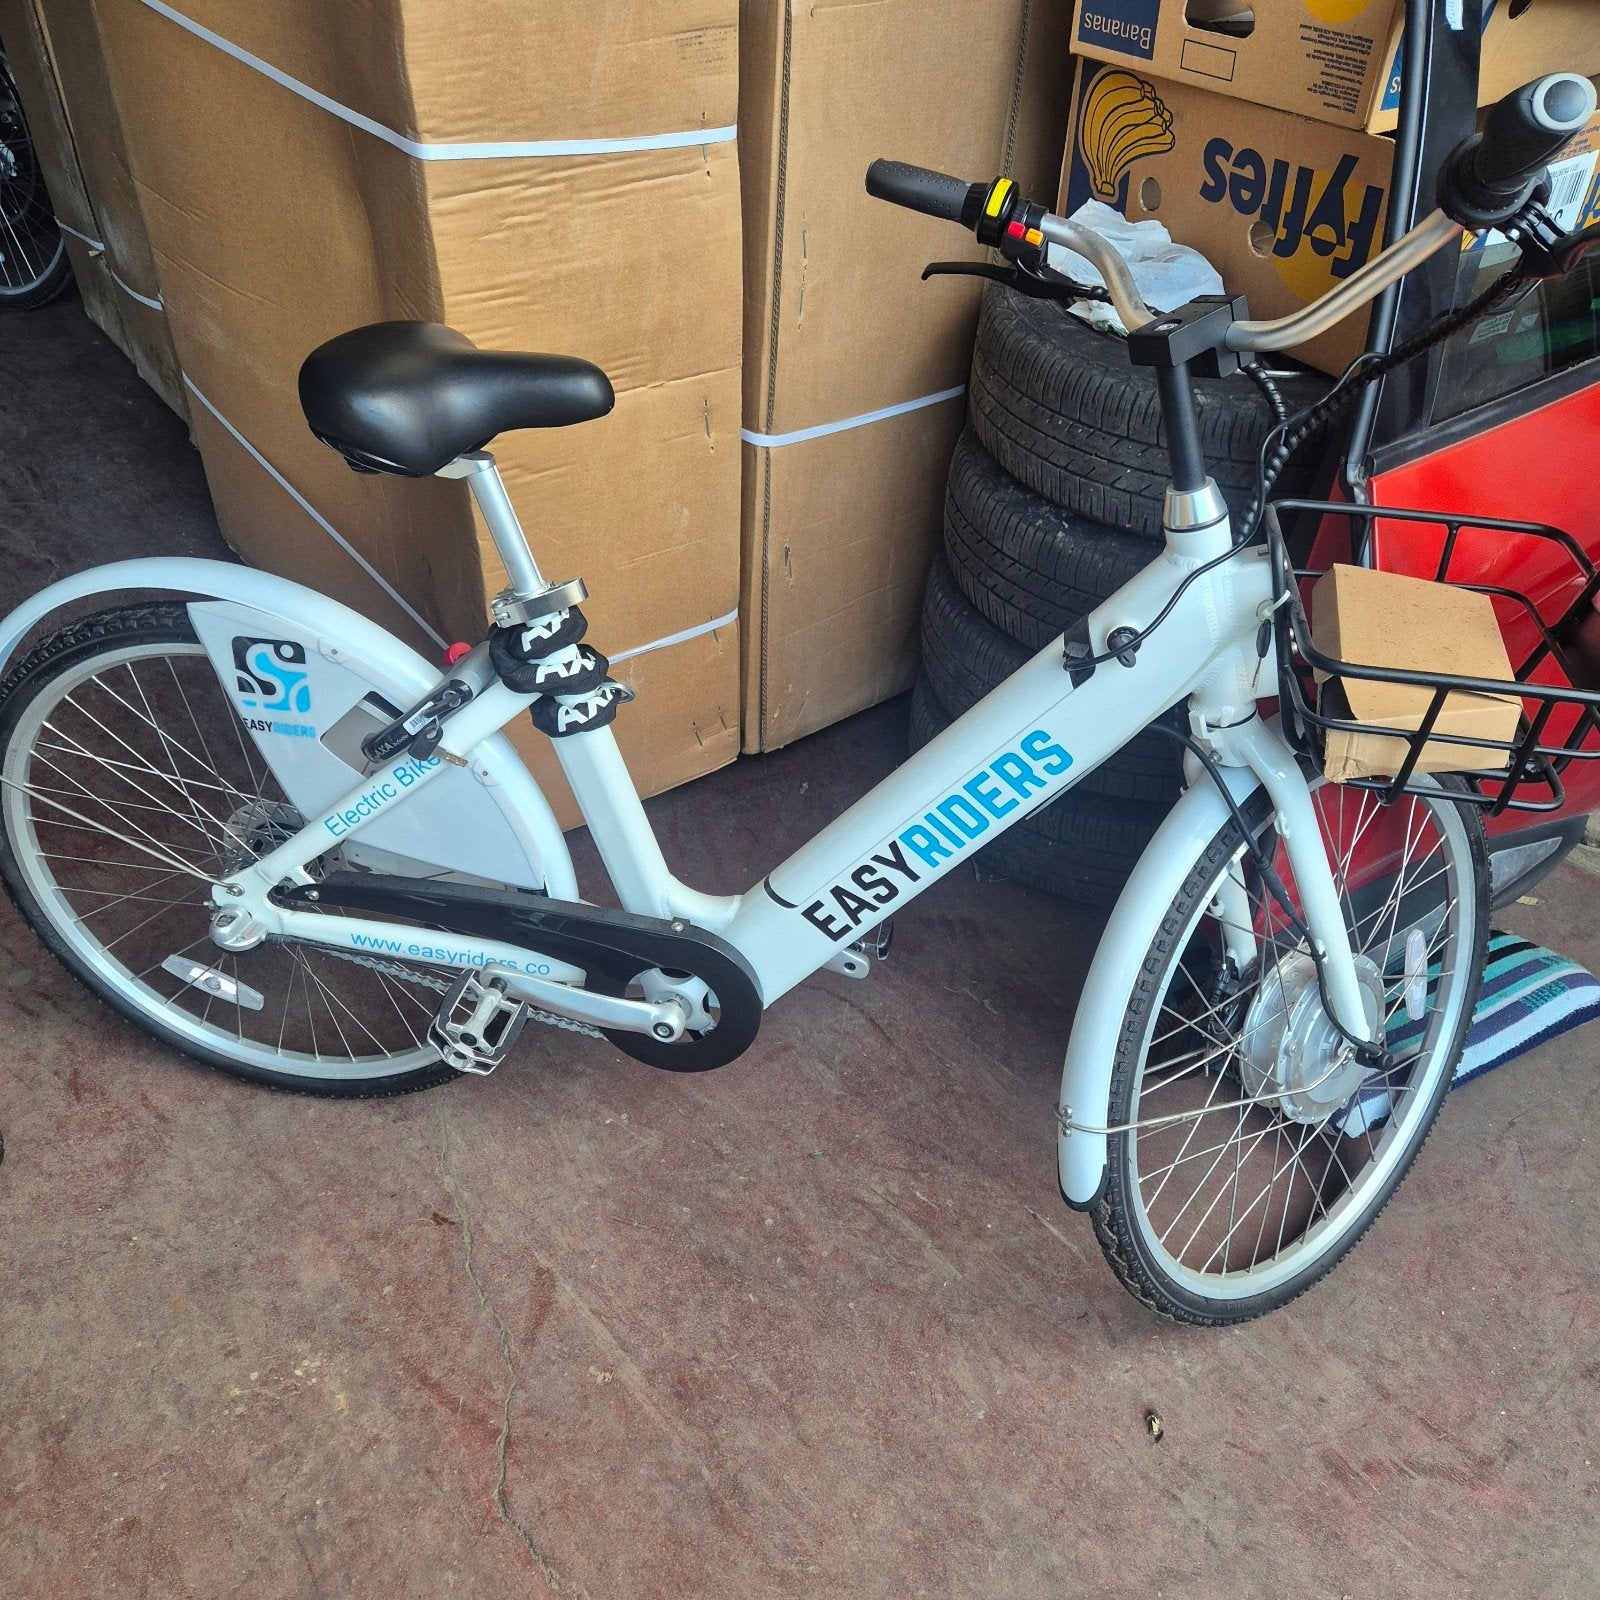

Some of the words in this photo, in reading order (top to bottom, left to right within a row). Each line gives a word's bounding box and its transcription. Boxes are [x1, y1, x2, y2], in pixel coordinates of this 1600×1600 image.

[1084, 12, 1151, 50] Bananas
[1199, 137, 1385, 279] Fyffes
[323, 783, 398, 837] Electric
[393, 756, 441, 787] Bike
[801, 730, 1073, 942] EASYRIDERS
[350, 933, 551, 975] www.easyridrsco
